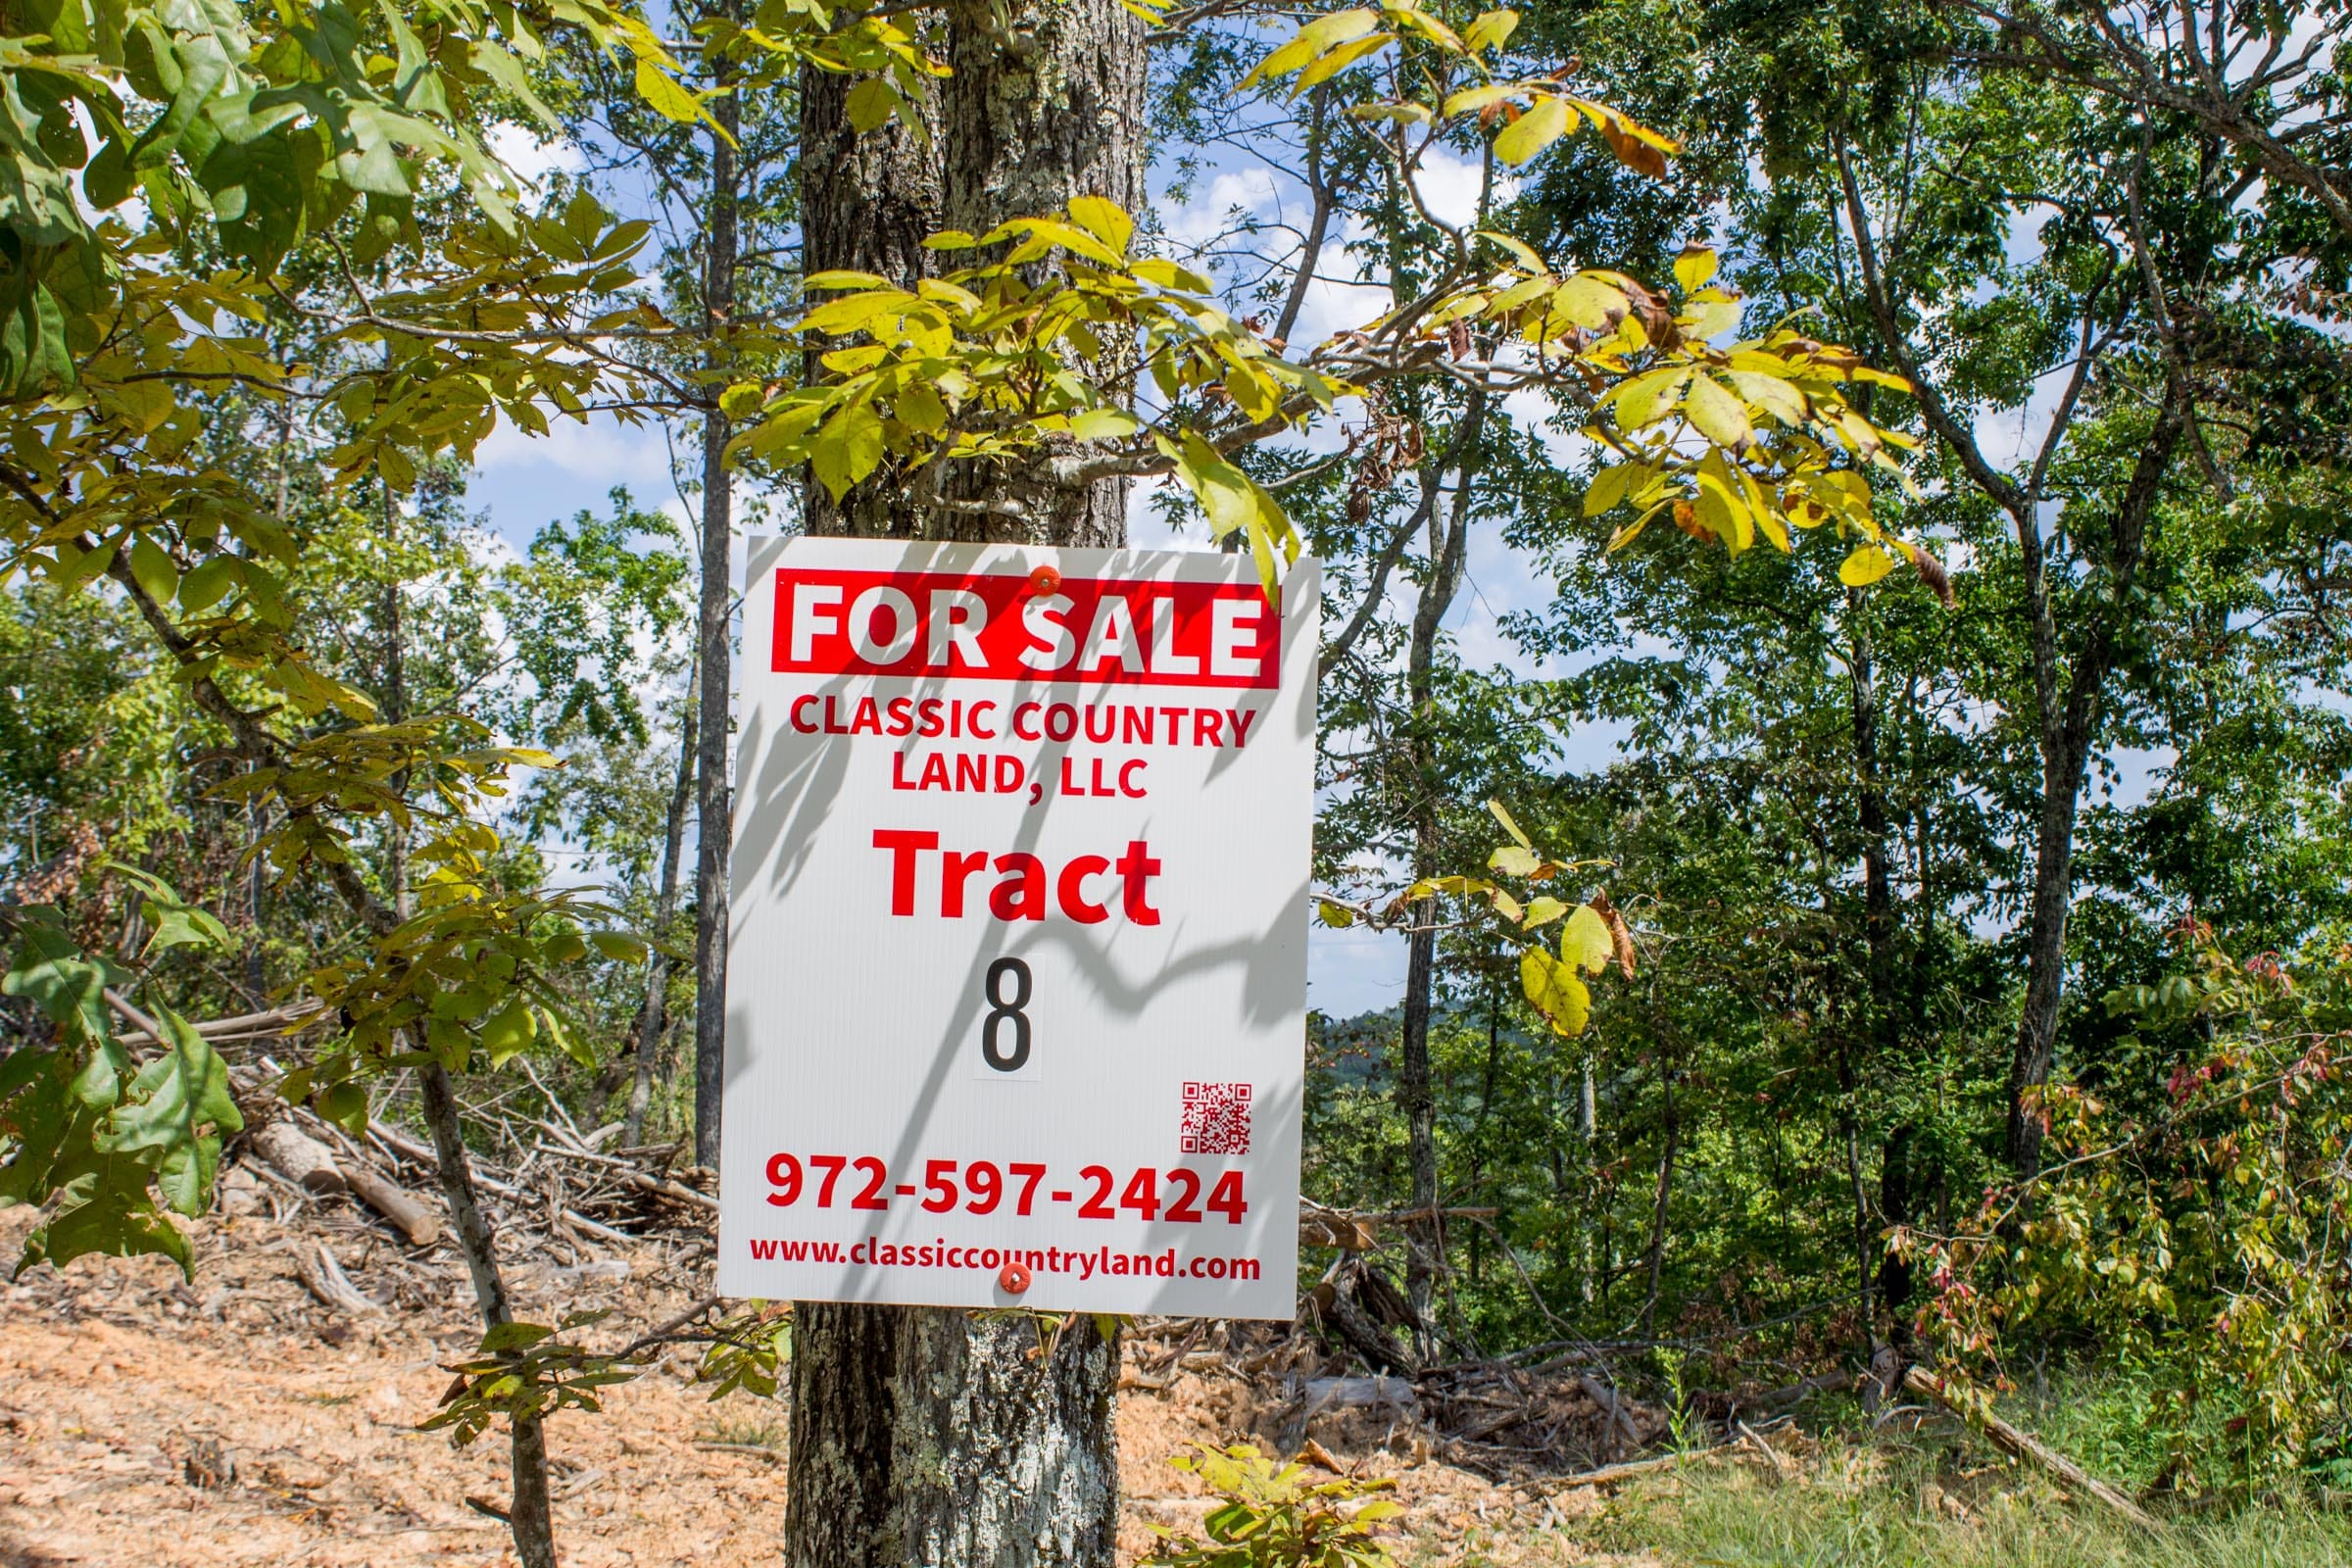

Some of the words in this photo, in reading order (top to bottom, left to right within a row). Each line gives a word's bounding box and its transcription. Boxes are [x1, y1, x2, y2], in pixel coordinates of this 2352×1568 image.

[790, 584, 989, 668] FOR
[1017, 592, 1262, 677] SALE
[790, 694, 996, 739] CLASSIC
[1013, 702, 1255, 748] COUNTRY
[893, 752, 1043, 806] LAND,
[1060, 757, 1148, 799] LLC
[872, 829, 1161, 926] Tract
[982, 956, 1033, 1072] 8
[765, 1152, 1248, 1224] 972-597-2424
[751, 1237, 1260, 1281] www.classiccountryland.com
